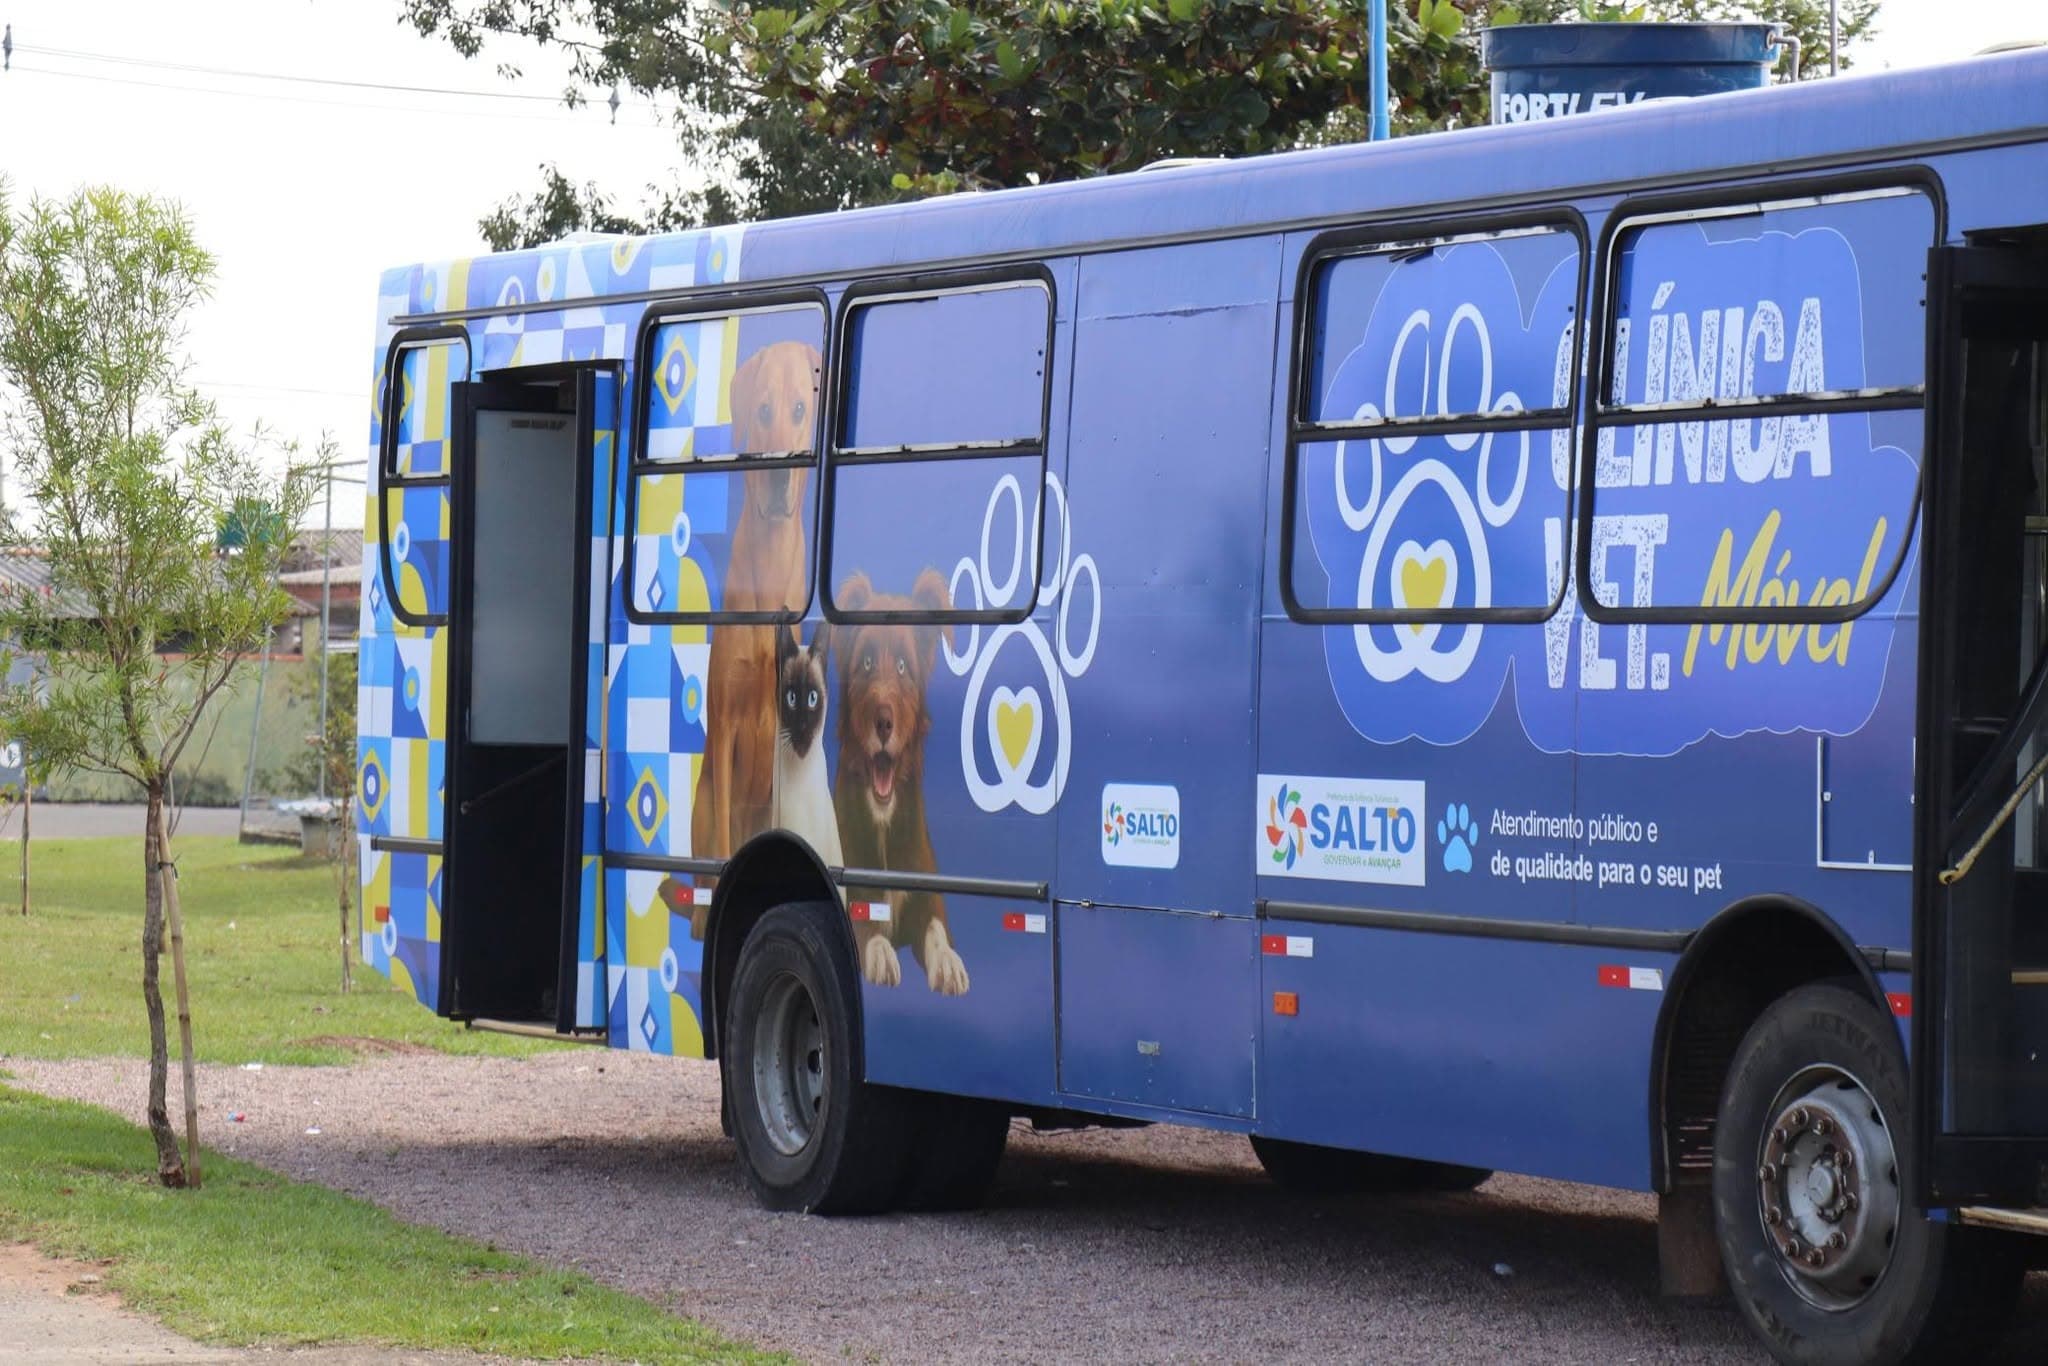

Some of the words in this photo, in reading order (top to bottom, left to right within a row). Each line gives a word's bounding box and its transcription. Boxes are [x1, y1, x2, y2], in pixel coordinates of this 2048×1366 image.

[1551, 281, 1832, 491] CLÍNICA
[1543, 513, 1670, 690] VET.
[1682, 508, 1887, 678] Móvel
[1126, 812, 1178, 837] SALTO
[1309, 803, 1416, 854] SALTO
[1490, 808, 1584, 839] Atendimento
[1588, 813, 1642, 846] público
[1647, 821, 1658, 843] e
[1491, 850, 1510, 876] de
[1515, 852, 1593, 883] qualidade
[1599, 861, 1635, 888] para
[1640, 864, 1651, 885] o
[1657, 864, 1688, 887] seu
[1694, 863, 1722, 894] pet
